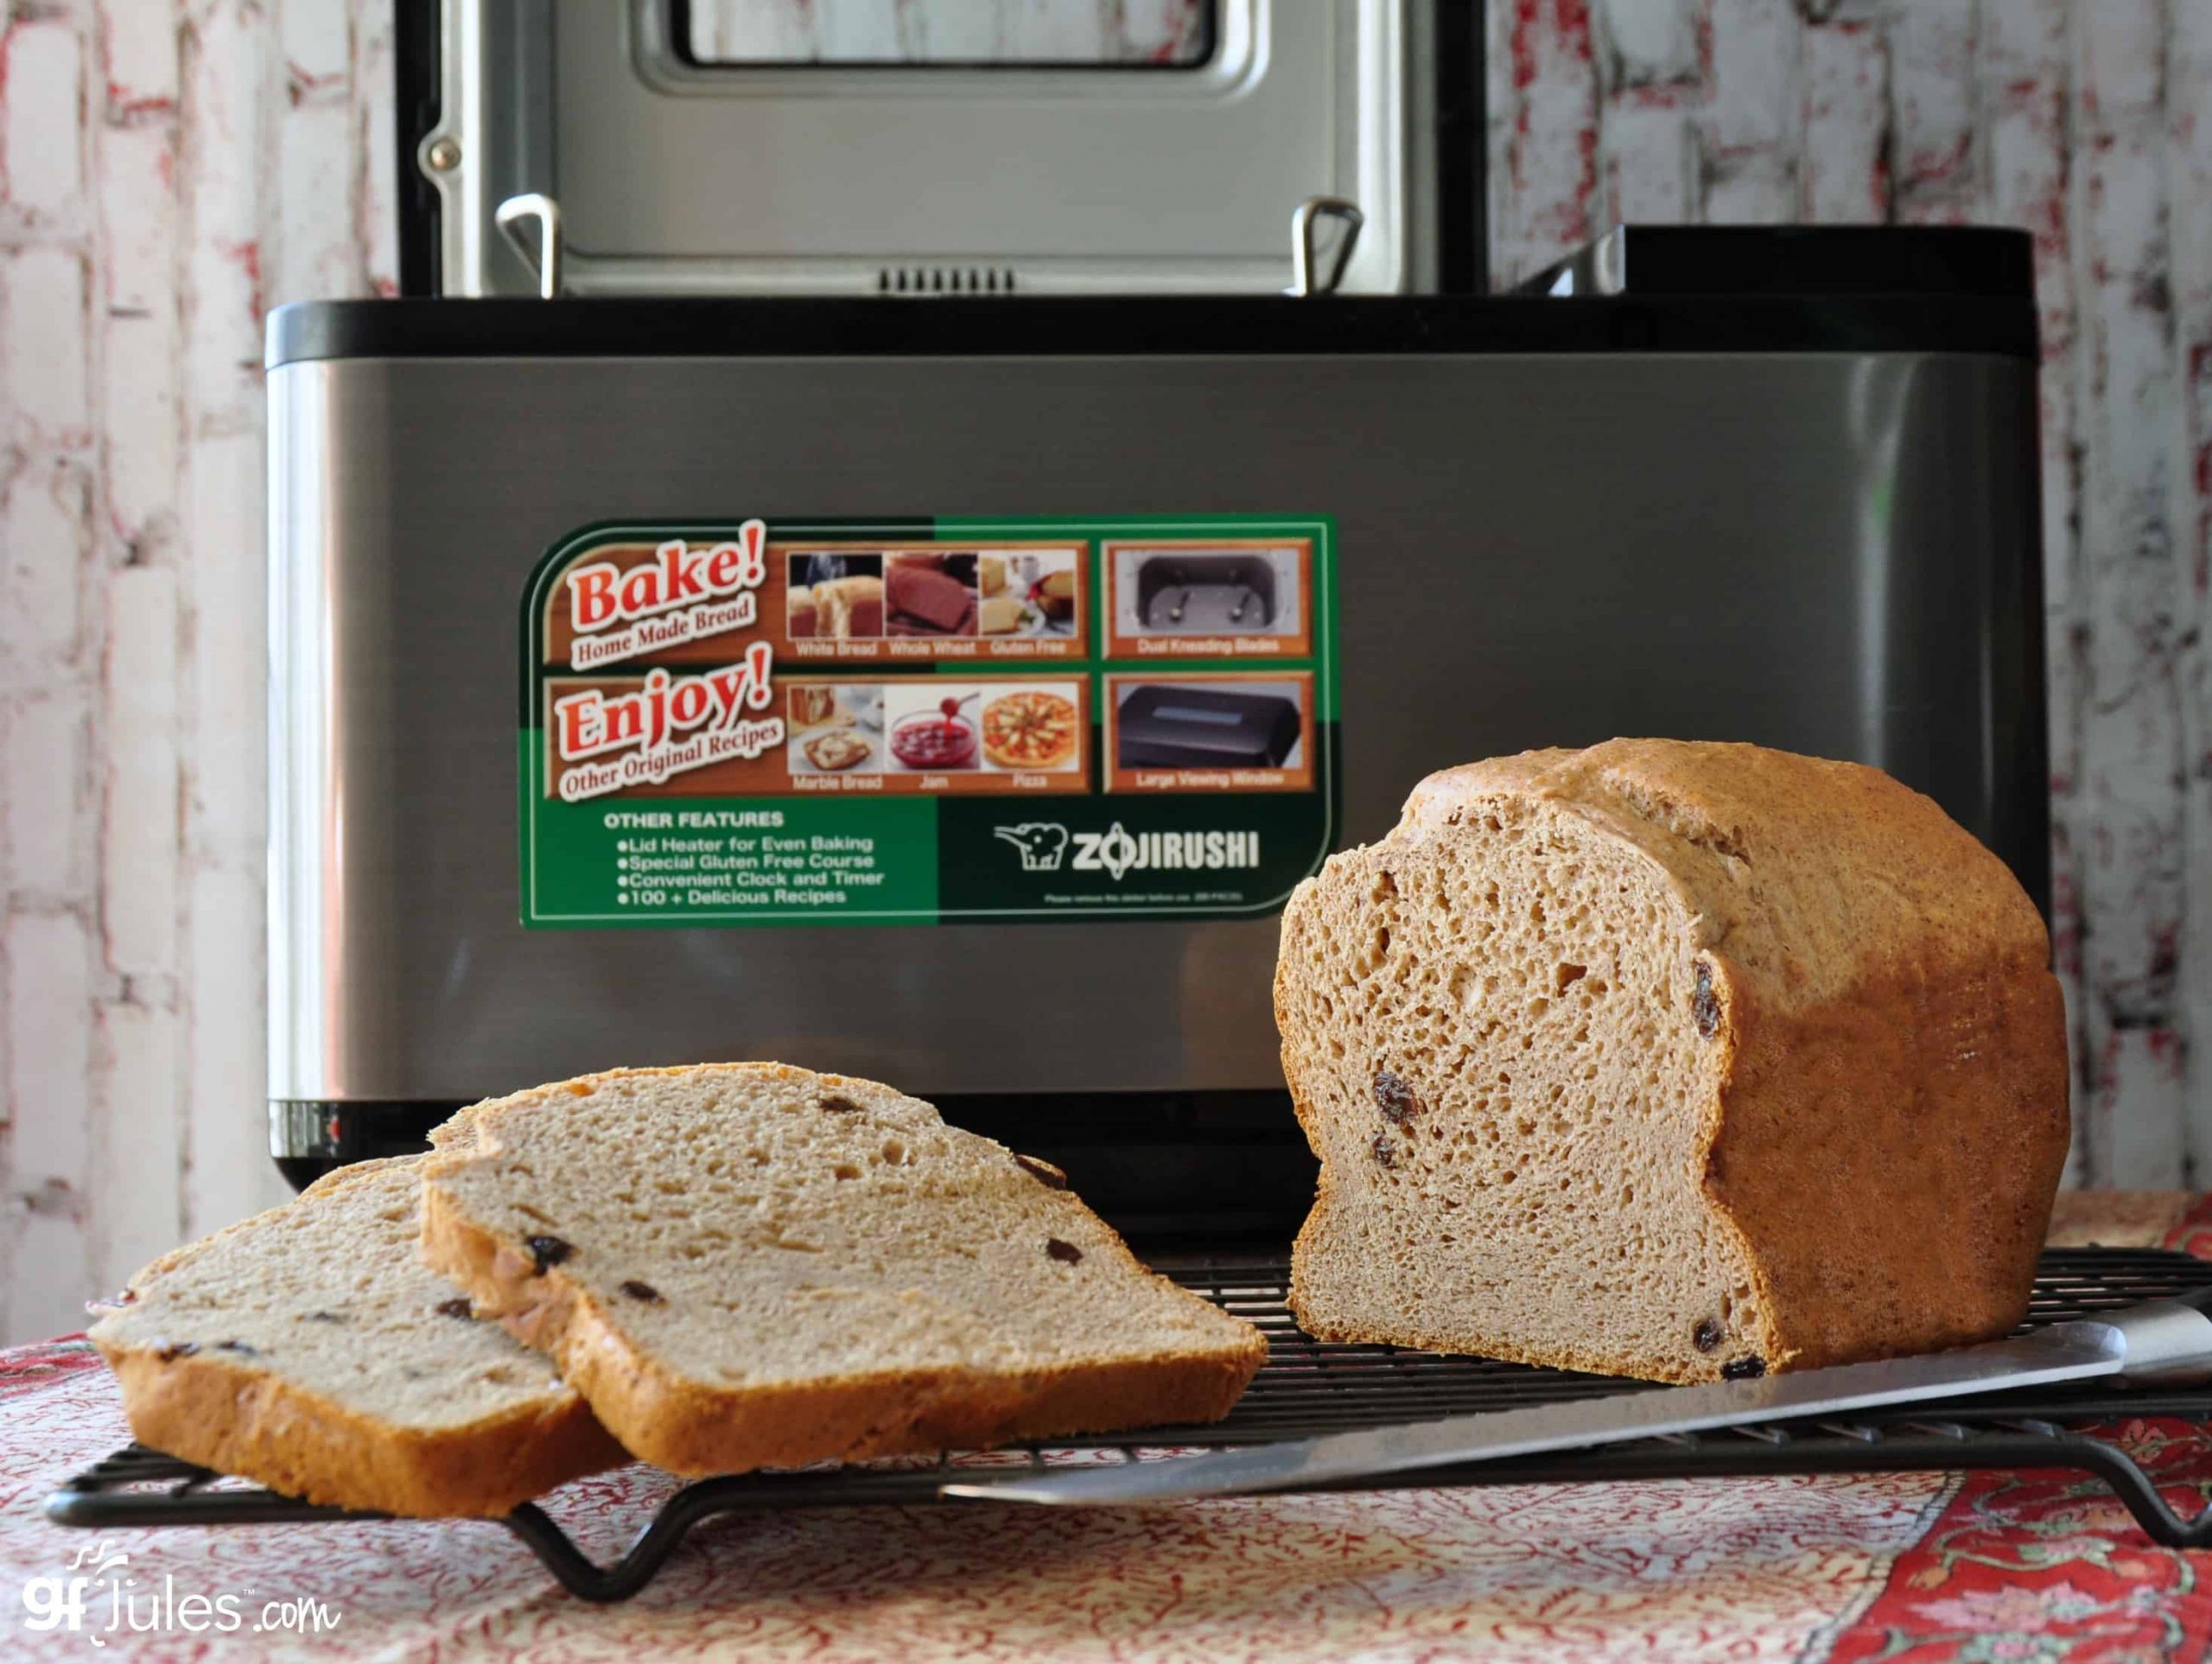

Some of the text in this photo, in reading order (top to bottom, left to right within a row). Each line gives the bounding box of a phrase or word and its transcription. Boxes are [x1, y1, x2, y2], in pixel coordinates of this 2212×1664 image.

[574, 525, 761, 626] Bake!
[577, 600, 750, 664] Home Made Bread
[796, 641, 834, 657] White
[562, 646, 772, 753] Enjoy!
[565, 722, 779, 795] Other Original Recipes
[919, 774, 949, 789] Jam
[604, 811, 785, 829] OTHER FEATURES
[629, 835, 874, 853] Lid Heater for Even Baking
[1071, 822, 1260, 880] ZOJIRUSHI
[629, 853, 874, 872] Special Gluten Free Course
[629, 870, 884, 887] Convenient Clock and Timer
[632, 889, 846, 905] 100 + Delicious Recipes
